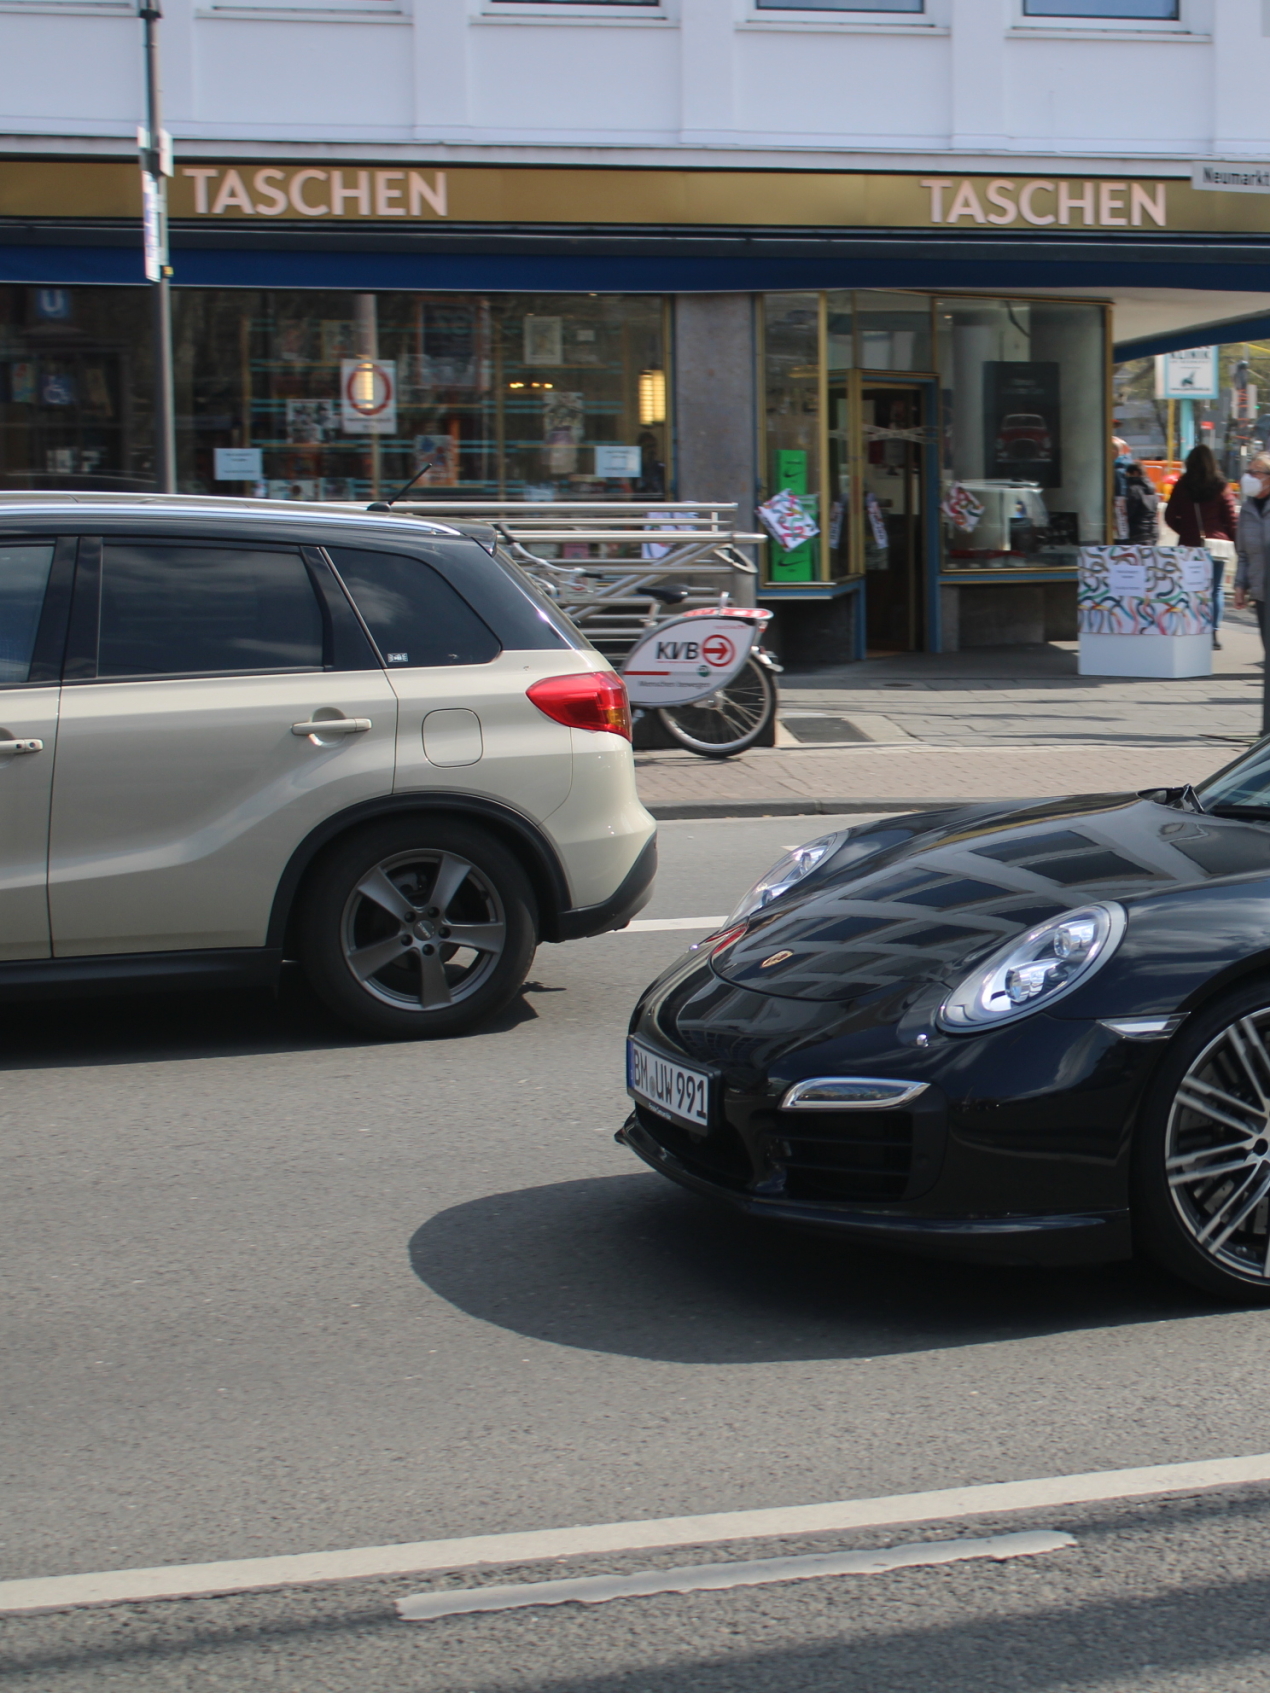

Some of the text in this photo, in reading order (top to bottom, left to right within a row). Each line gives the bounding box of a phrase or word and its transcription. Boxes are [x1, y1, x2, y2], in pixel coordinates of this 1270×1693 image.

[182, 168, 448, 216] TASCHEN
[1203, 167, 1270, 187] Neumarkt
[920, 179, 1166, 226] TASCHEN
[656, 641, 699, 660] KVB
[634, 1049, 707, 1119] BM UW 991
